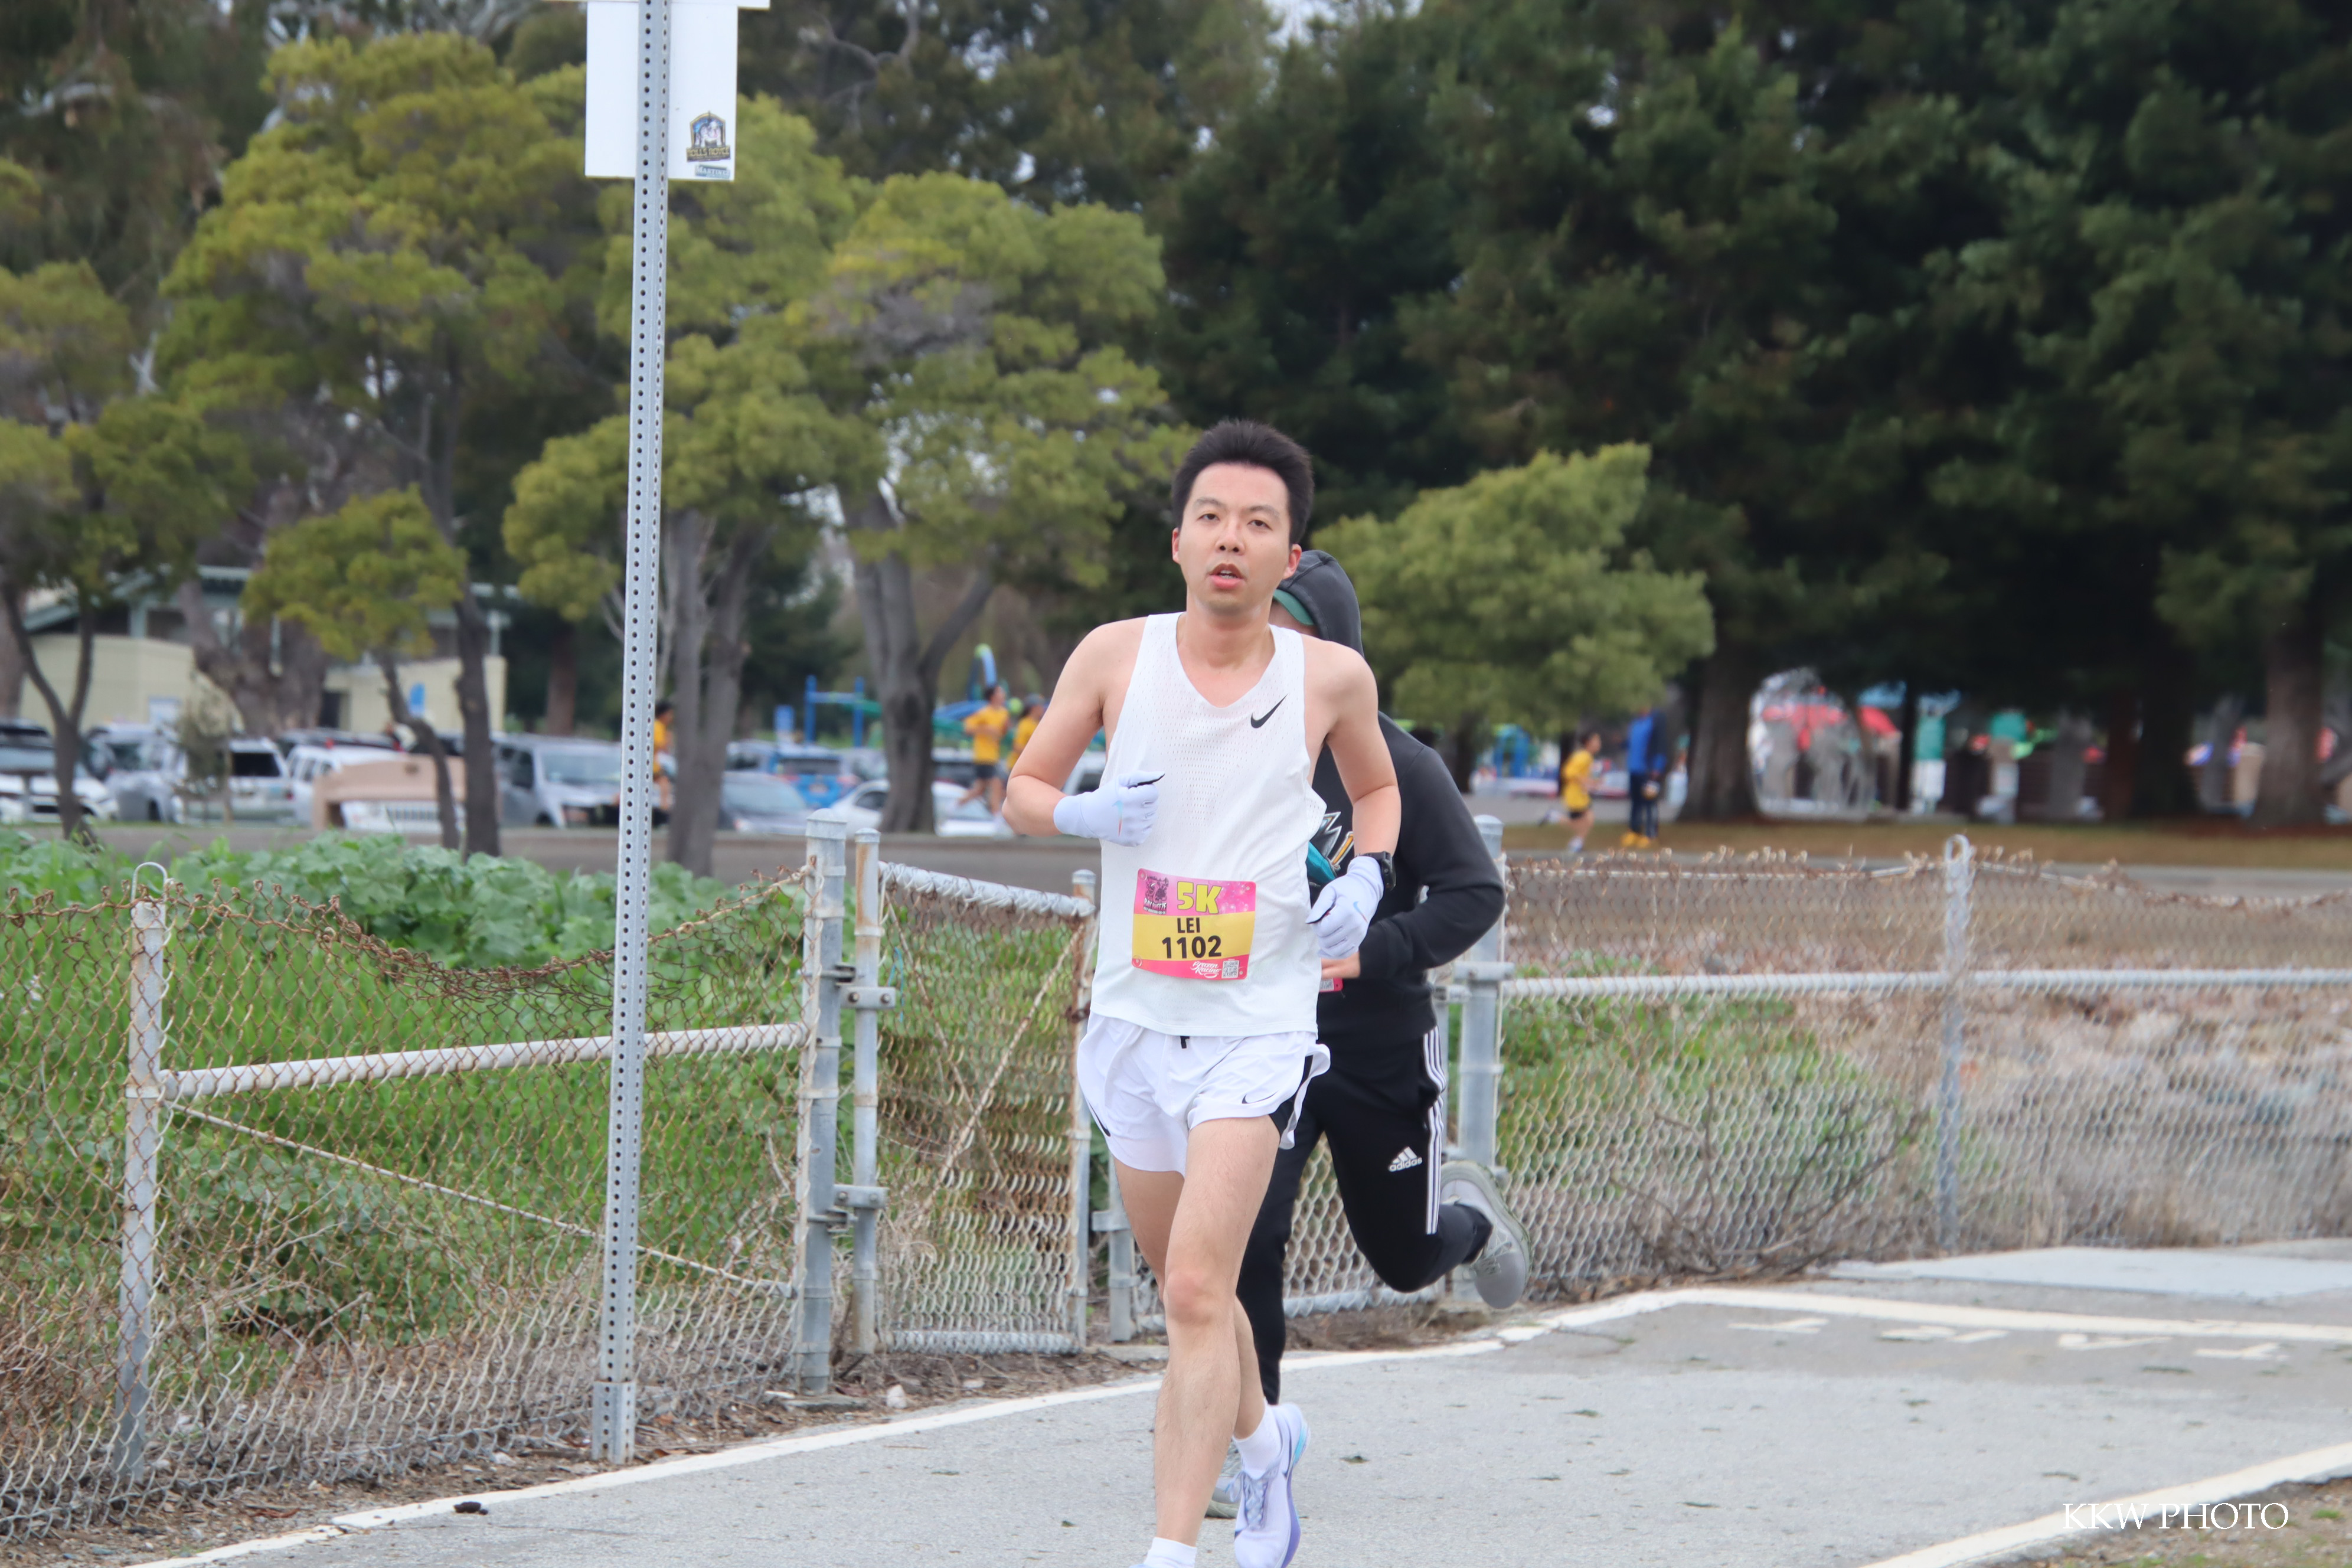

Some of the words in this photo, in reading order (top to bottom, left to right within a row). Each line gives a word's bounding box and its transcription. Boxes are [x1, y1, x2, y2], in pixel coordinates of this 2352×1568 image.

[1177, 881, 1222, 914] 5K
[1177, 917, 1200, 933] LEI
[1162, 935, 1221, 959] 1102
[1389, 1157, 1422, 1171] adidas
